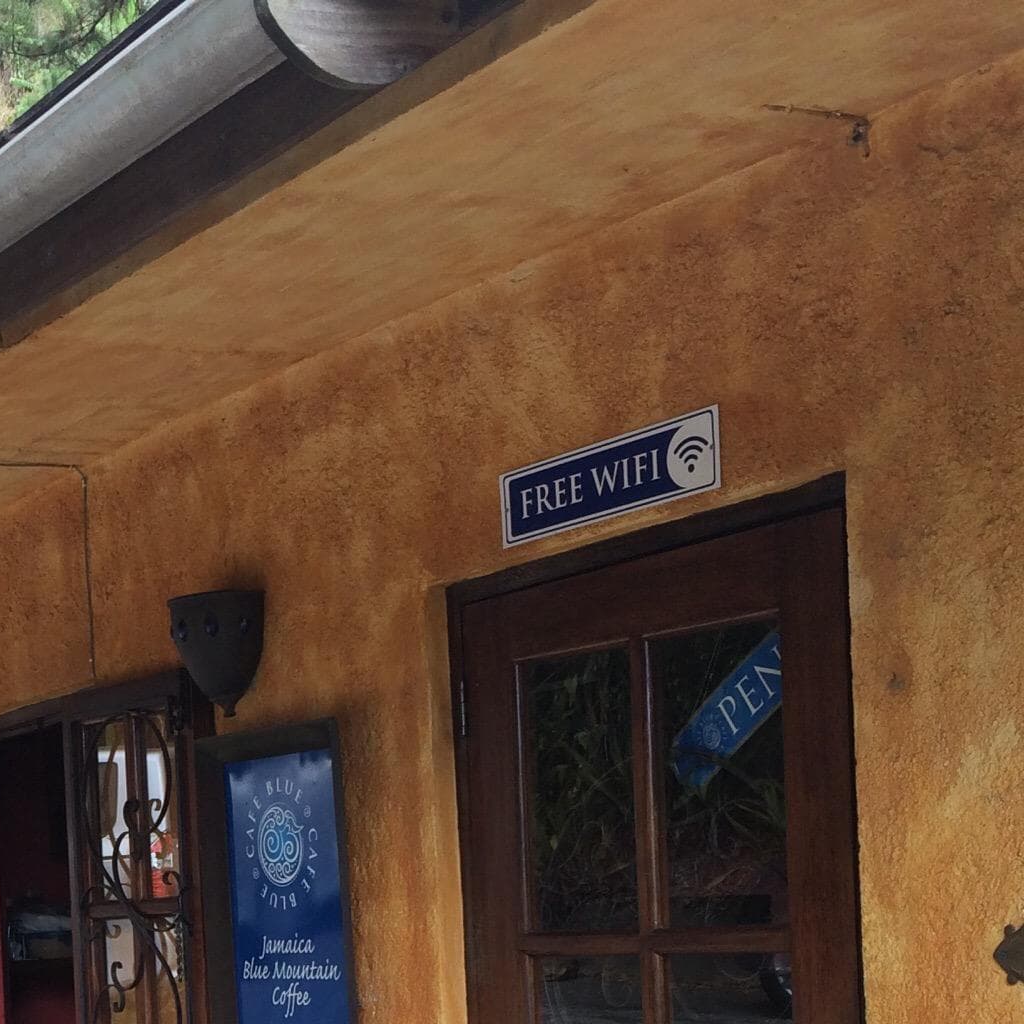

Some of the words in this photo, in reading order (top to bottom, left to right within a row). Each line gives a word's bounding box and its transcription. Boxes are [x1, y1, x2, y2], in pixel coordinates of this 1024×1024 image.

[520, 472, 584, 519] FREE
[590, 449, 661, 496] WIFI
[245, 796, 263, 858] CAFE
[265, 777, 304, 804] BLUE
[301, 828, 319, 893] CAFE
[260, 884, 297, 910] BLUE
[259, 932, 316, 960] Jamaica
[243, 957, 271, 980] Blue
[272, 959, 342, 981] Mountain
[272, 982, 312, 1018] Coffee
